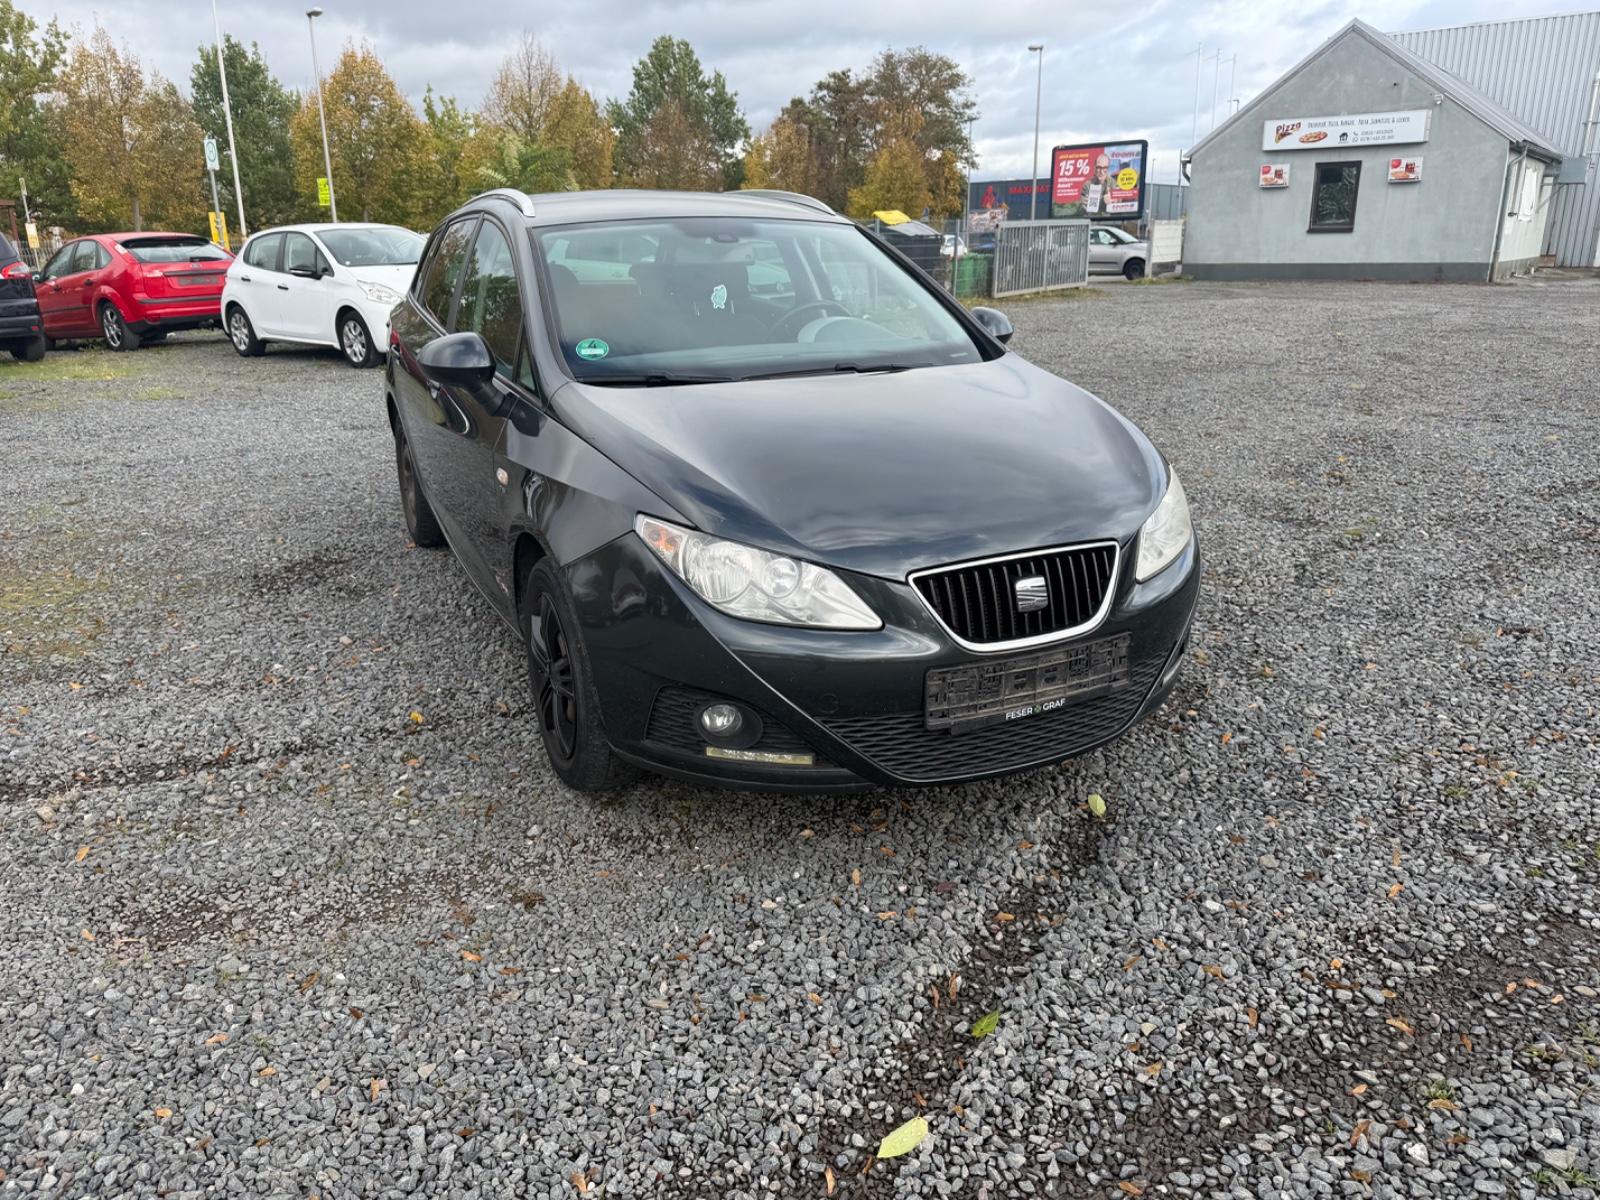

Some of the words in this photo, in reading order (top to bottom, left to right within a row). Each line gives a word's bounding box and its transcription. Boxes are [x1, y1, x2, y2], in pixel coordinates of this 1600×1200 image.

[1059, 159, 1075, 176] 15
[1076, 158, 1090, 175] %
[1005, 707, 1033, 721] FESER
[1042, 699, 1066, 710] GRAF
